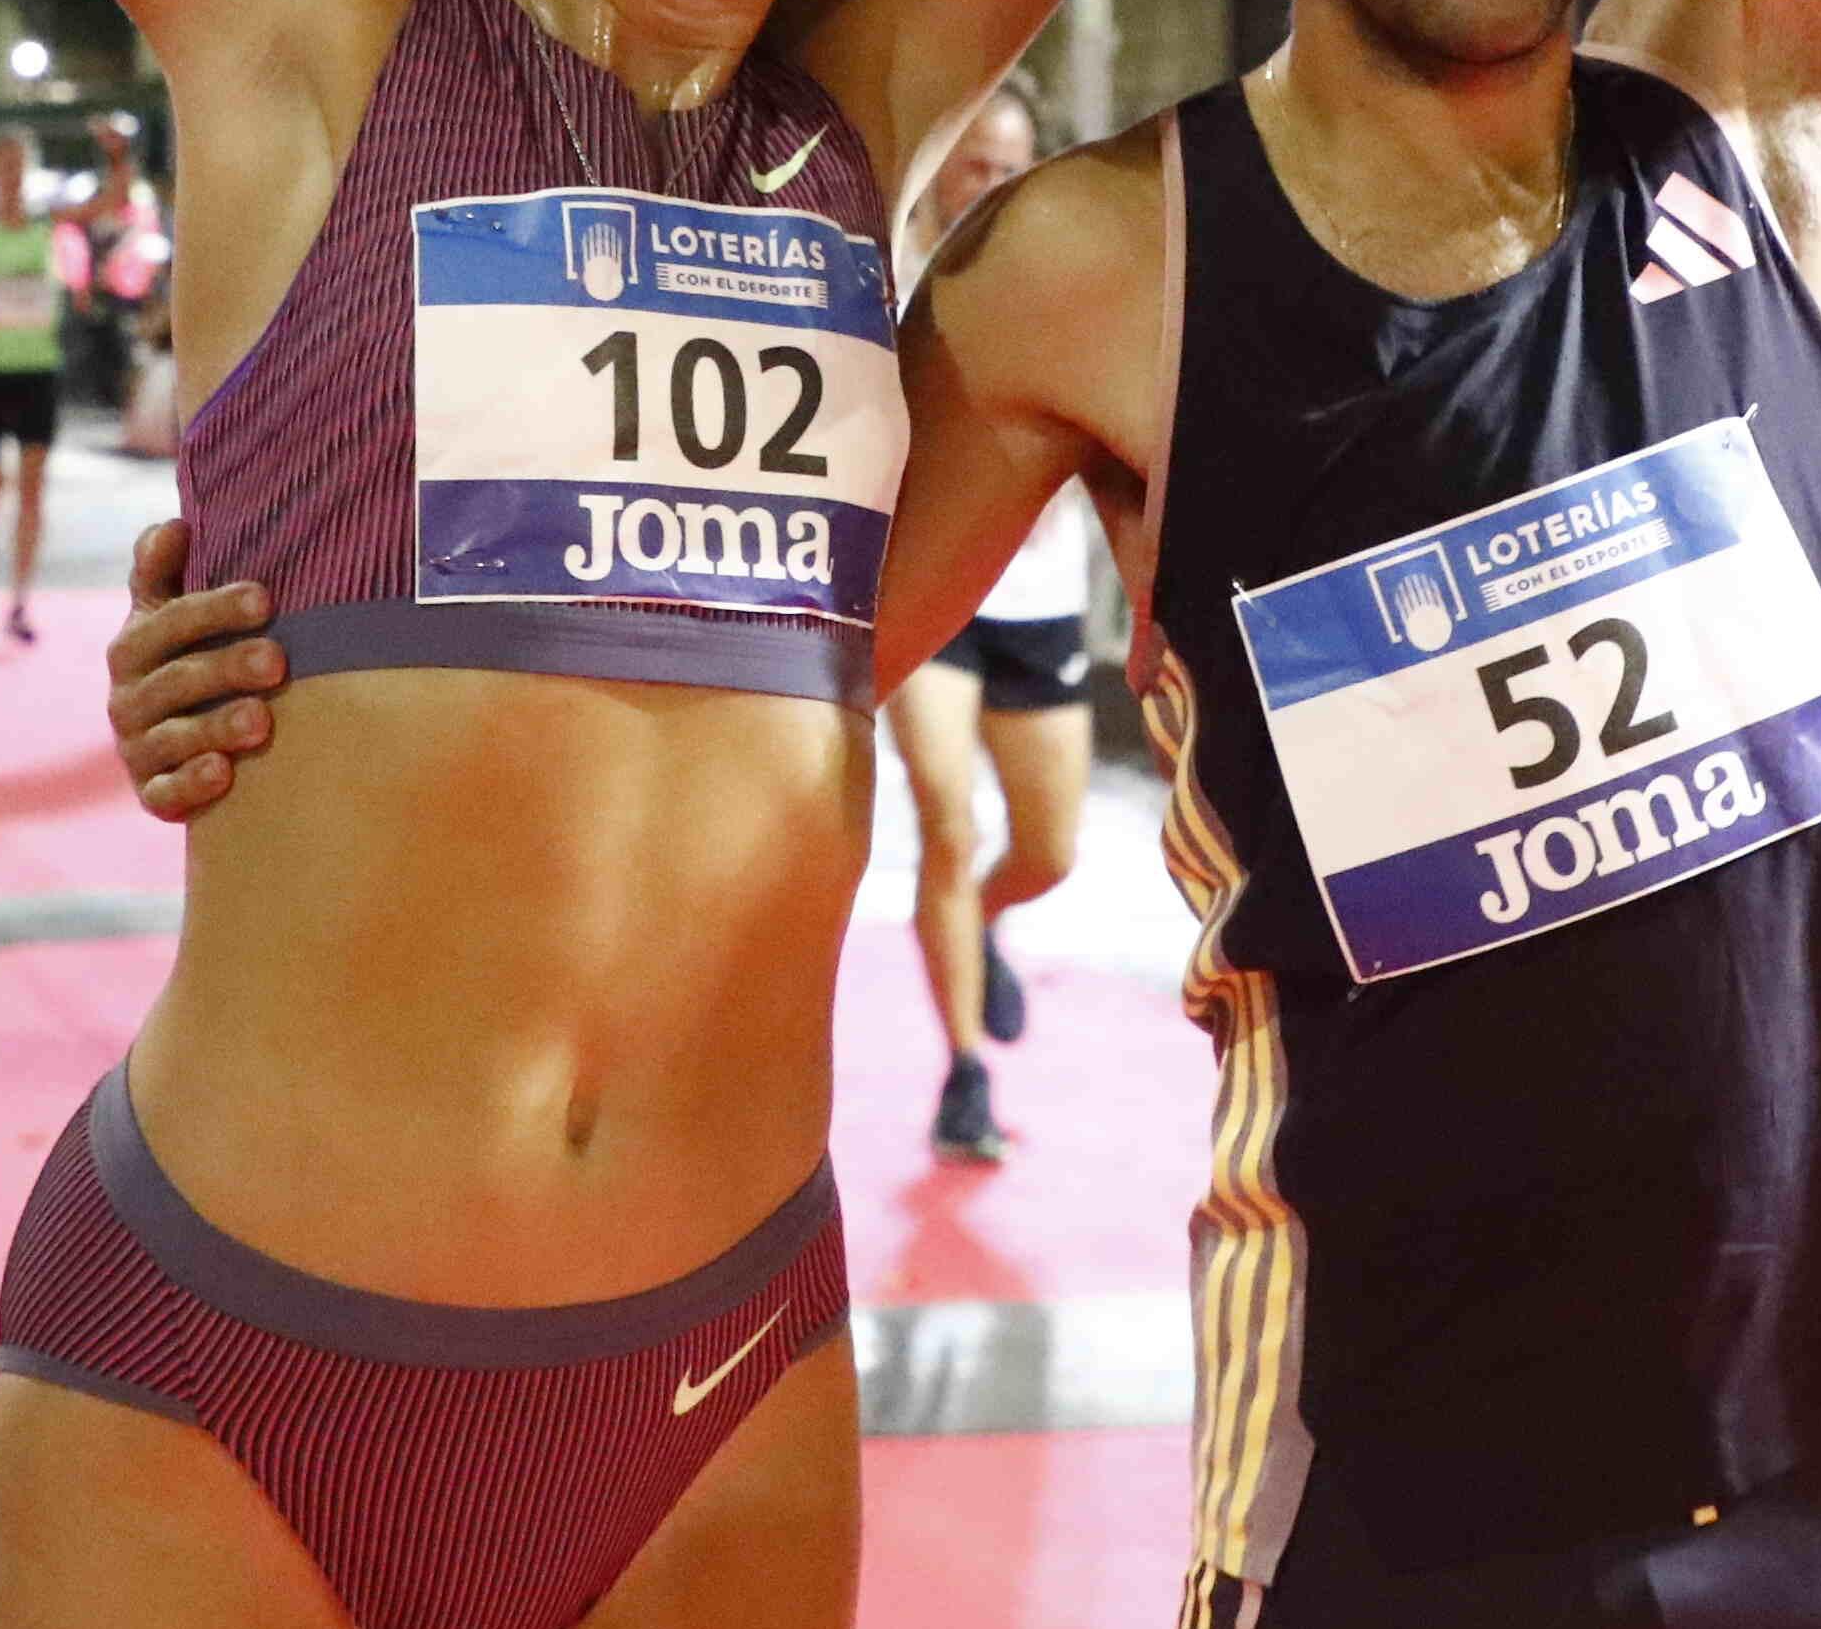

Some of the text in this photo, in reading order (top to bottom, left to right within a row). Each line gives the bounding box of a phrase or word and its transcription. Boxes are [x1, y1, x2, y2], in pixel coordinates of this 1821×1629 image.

[650, 222, 827, 271] LOTERÍAS
[675, 272, 813, 299] CON EL DEPORTE
[581, 330, 828, 477] 102
[1465, 480, 1658, 576] LOTERÍAS
[1504, 533, 1648, 597] CON EL DEPORTE
[1477, 617, 1679, 790] 52
